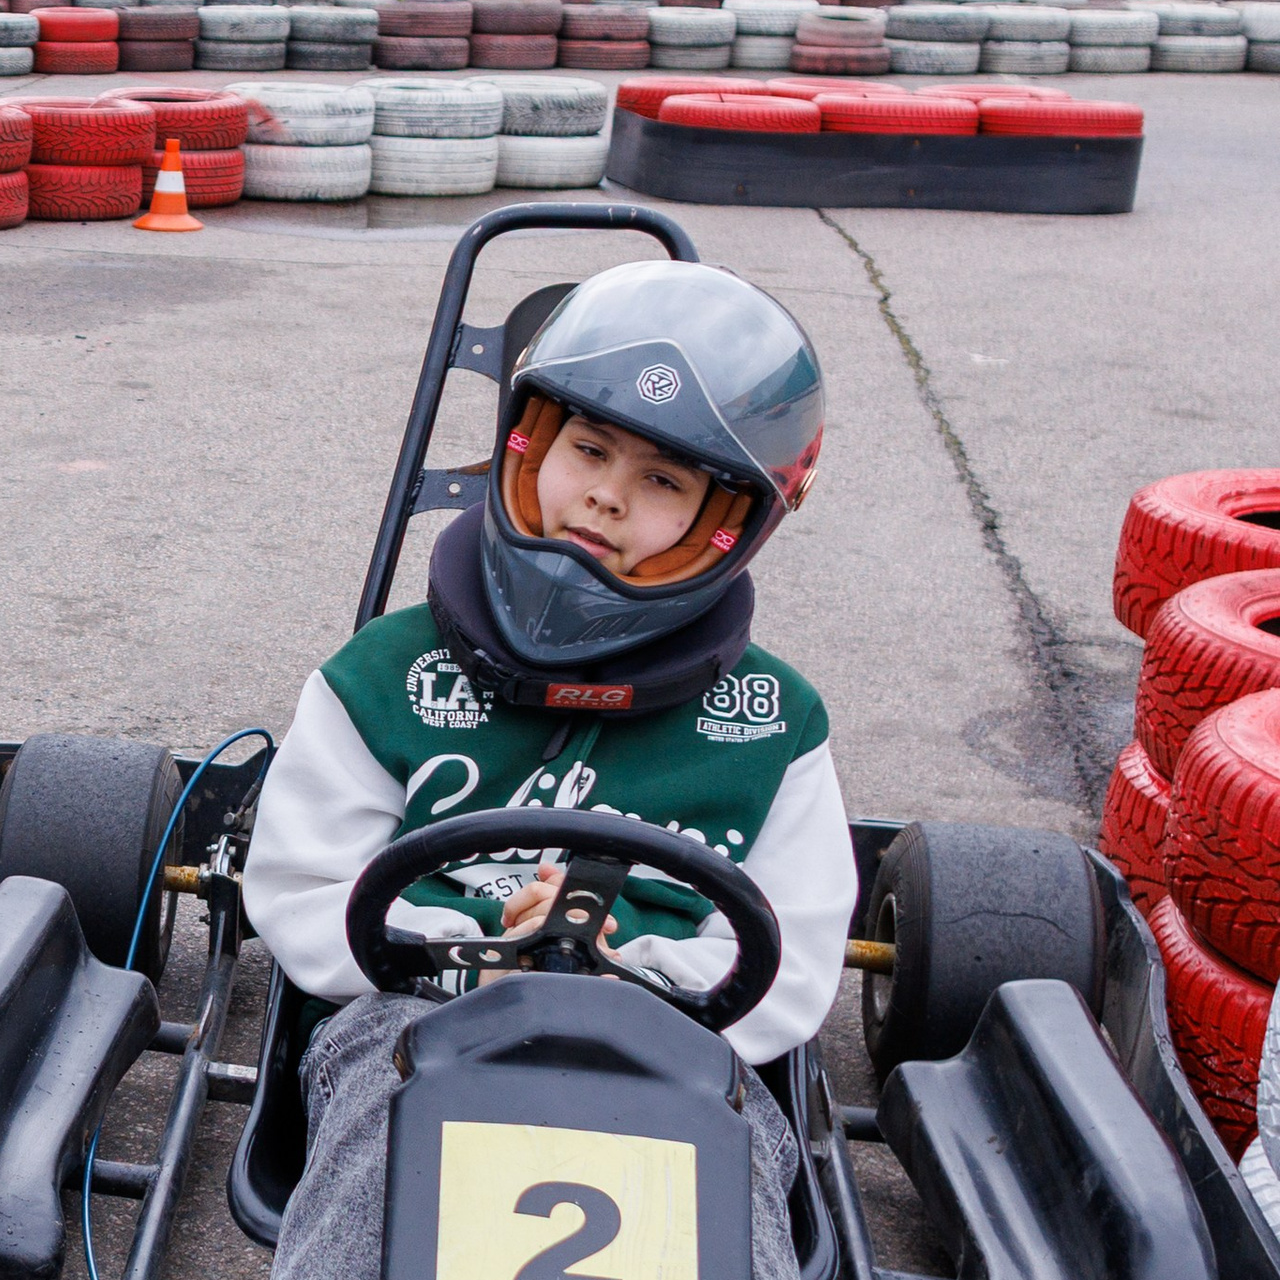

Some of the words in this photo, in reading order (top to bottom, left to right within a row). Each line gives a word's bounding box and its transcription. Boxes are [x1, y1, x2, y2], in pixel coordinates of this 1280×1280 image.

[406, 648, 451, 692] UNIVERSIT
[420, 672, 480, 710] LA
[553, 688, 626, 702] RLG
[703, 673, 779, 722] 88
[412, 704, 489, 722] CALIFORNIA
[422, 717, 446, 728] WEST
[449, 721, 478, 729] COAST
[702, 722, 742, 735] ATHLETIC
[743, 724, 780, 736] DIVISION
